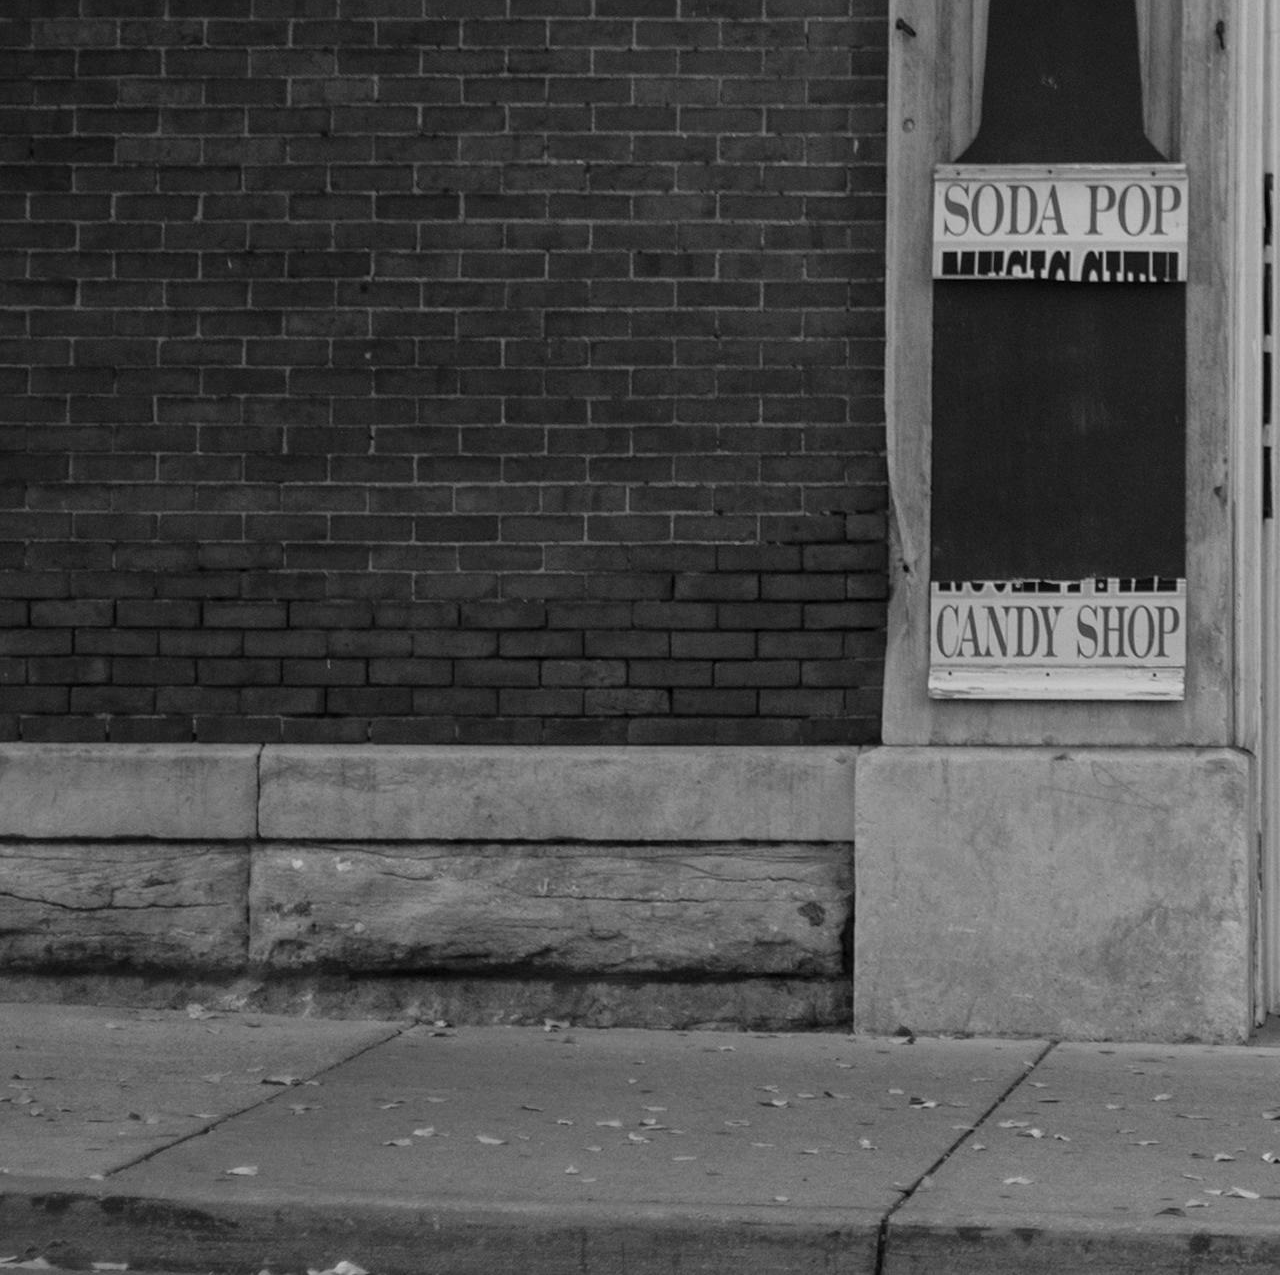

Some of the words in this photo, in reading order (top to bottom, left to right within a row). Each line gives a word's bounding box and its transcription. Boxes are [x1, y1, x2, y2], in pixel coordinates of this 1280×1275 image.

[943, 184, 1070, 237] SODA
[1085, 184, 1182, 237] POP
[936, 604, 1064, 659] CANDY
[1076, 604, 1181, 660] SHOP
